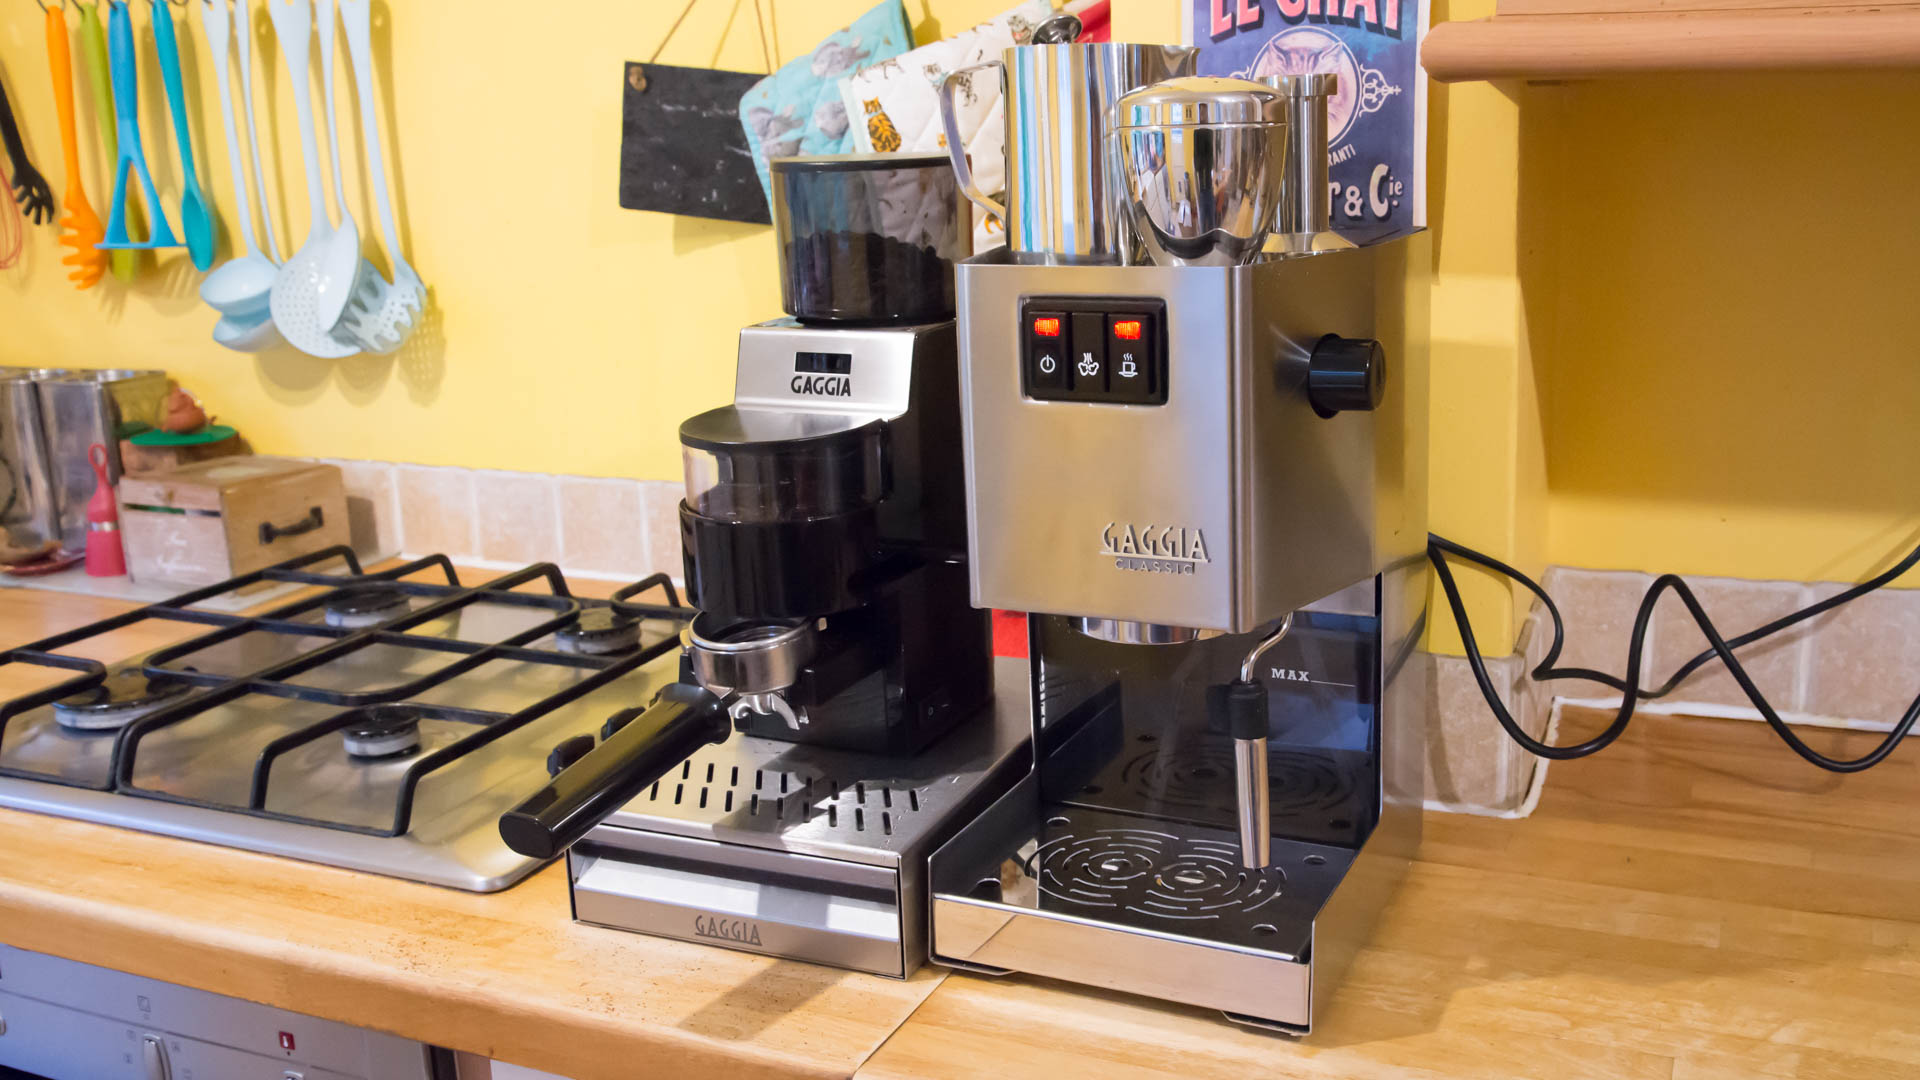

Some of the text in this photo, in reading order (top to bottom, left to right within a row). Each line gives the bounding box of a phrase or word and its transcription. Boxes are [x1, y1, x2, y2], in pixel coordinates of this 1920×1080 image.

[1344, 185, 1363, 217] &
[790, 375, 852, 397] GAGGIA
[1100, 521, 1211, 563] GAGGIA
[1115, 558, 1194, 576] CLASSIC
[1271, 667, 1310, 682] MAX
[694, 914, 763, 947] GAGGIA
